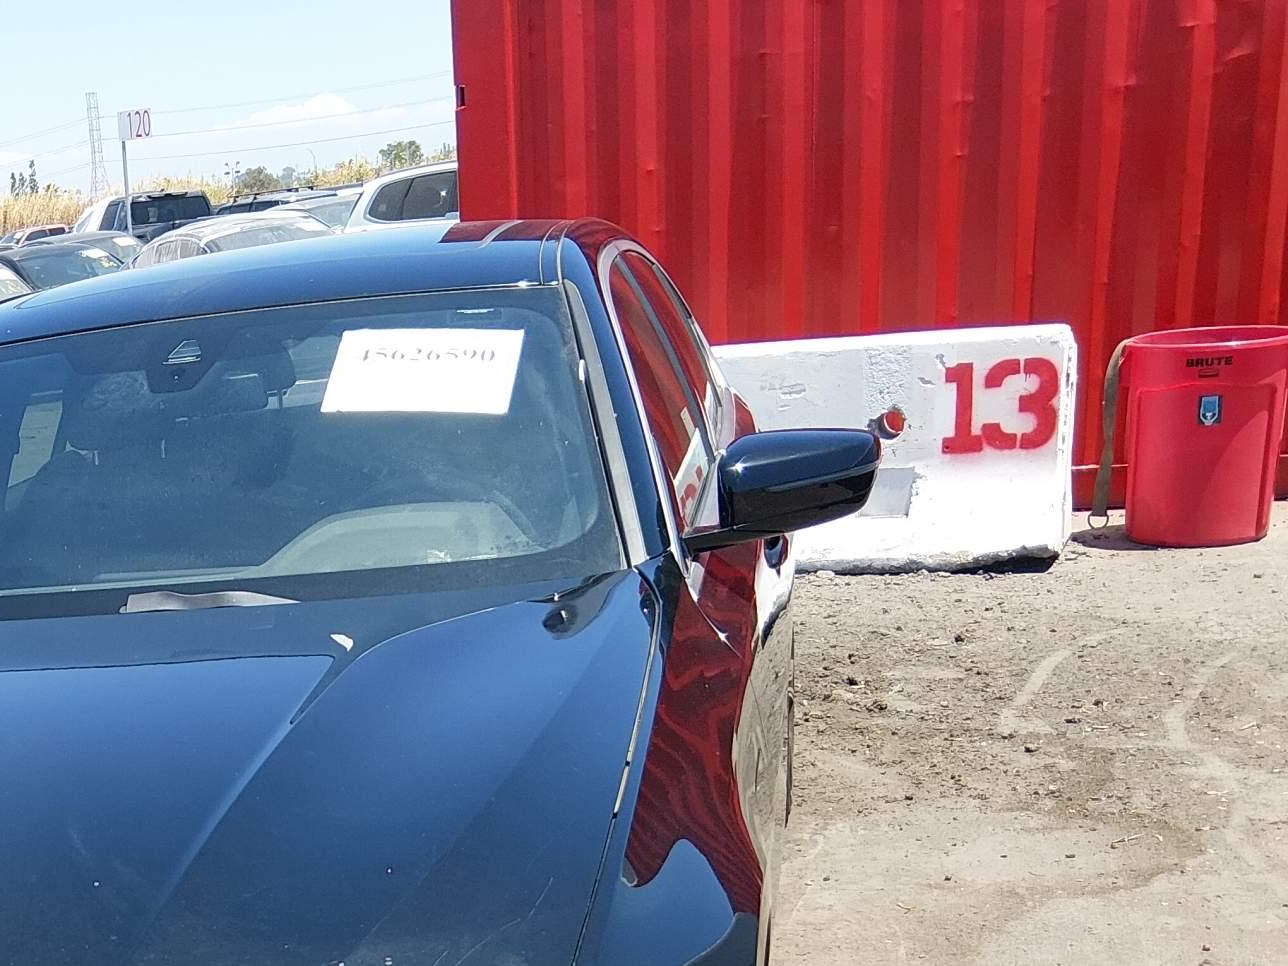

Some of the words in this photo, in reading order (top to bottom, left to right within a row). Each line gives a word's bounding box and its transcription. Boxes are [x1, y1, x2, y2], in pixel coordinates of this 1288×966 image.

[127, 110, 151, 138] 120
[1186, 355, 1233, 368] BRUTE
[941, 356, 1059, 454] 13
